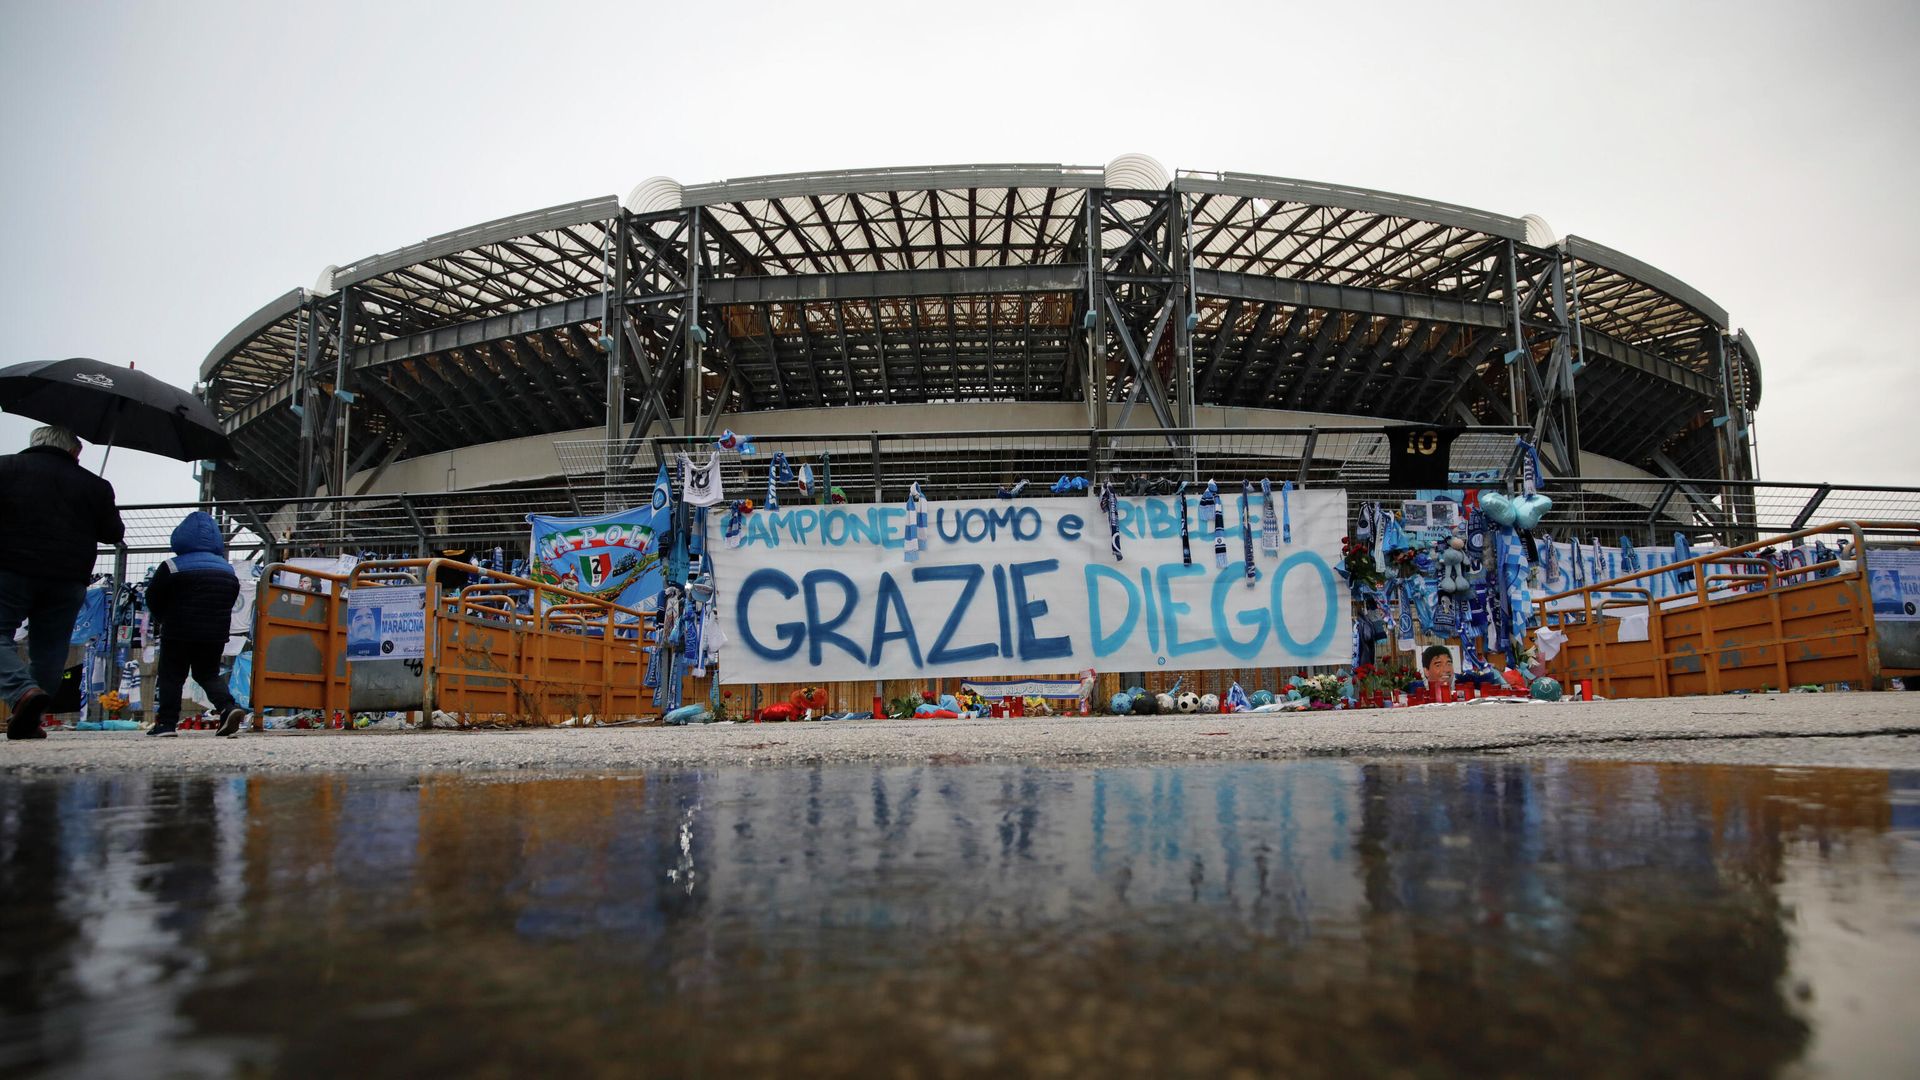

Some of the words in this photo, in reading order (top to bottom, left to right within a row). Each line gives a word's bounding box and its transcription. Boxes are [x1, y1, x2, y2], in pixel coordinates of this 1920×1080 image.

[1406, 430, 1438, 456] 10
[936, 506, 1042, 543] UOMO
[1056, 515, 1085, 541] e
[540, 525, 657, 564] NAPOLI
[591, 558, 602, 575] 2
[736, 557, 1073, 669] GRAZIE
[1085, 550, 1338, 661] DIEGO
[382, 619, 424, 634] MARADONA
[1005, 684, 1044, 695] NAPOLI
